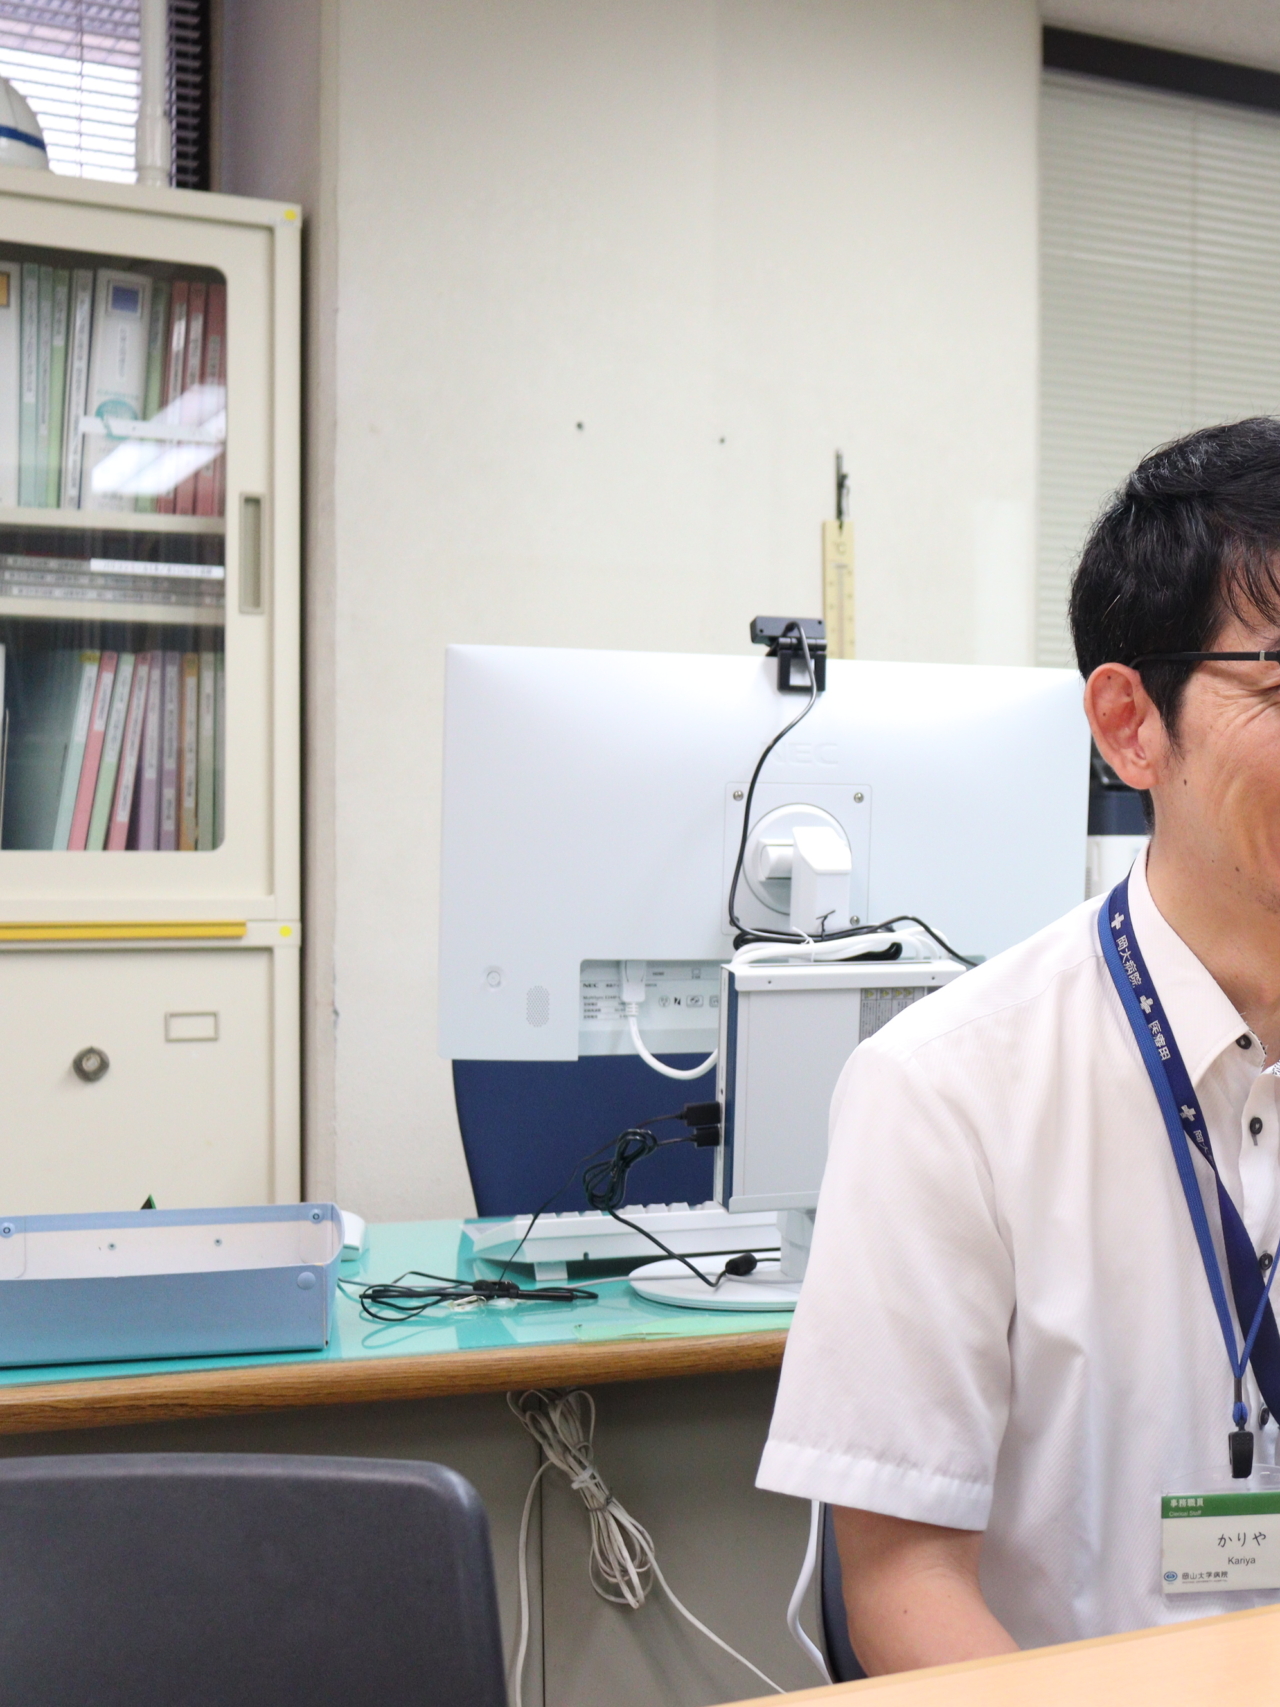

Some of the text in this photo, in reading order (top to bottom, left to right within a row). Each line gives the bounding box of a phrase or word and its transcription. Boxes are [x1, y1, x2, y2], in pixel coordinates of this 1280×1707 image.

[1116, 934, 1142, 988] 岡大病院
[1170, 1497, 1204, 1508] 事務職員
[1217, 1531, 1267, 1548] かりや
[1227, 1556, 1256, 1567] Kariya
[1182, 1570, 1228, 1580] 岡山大学病院
